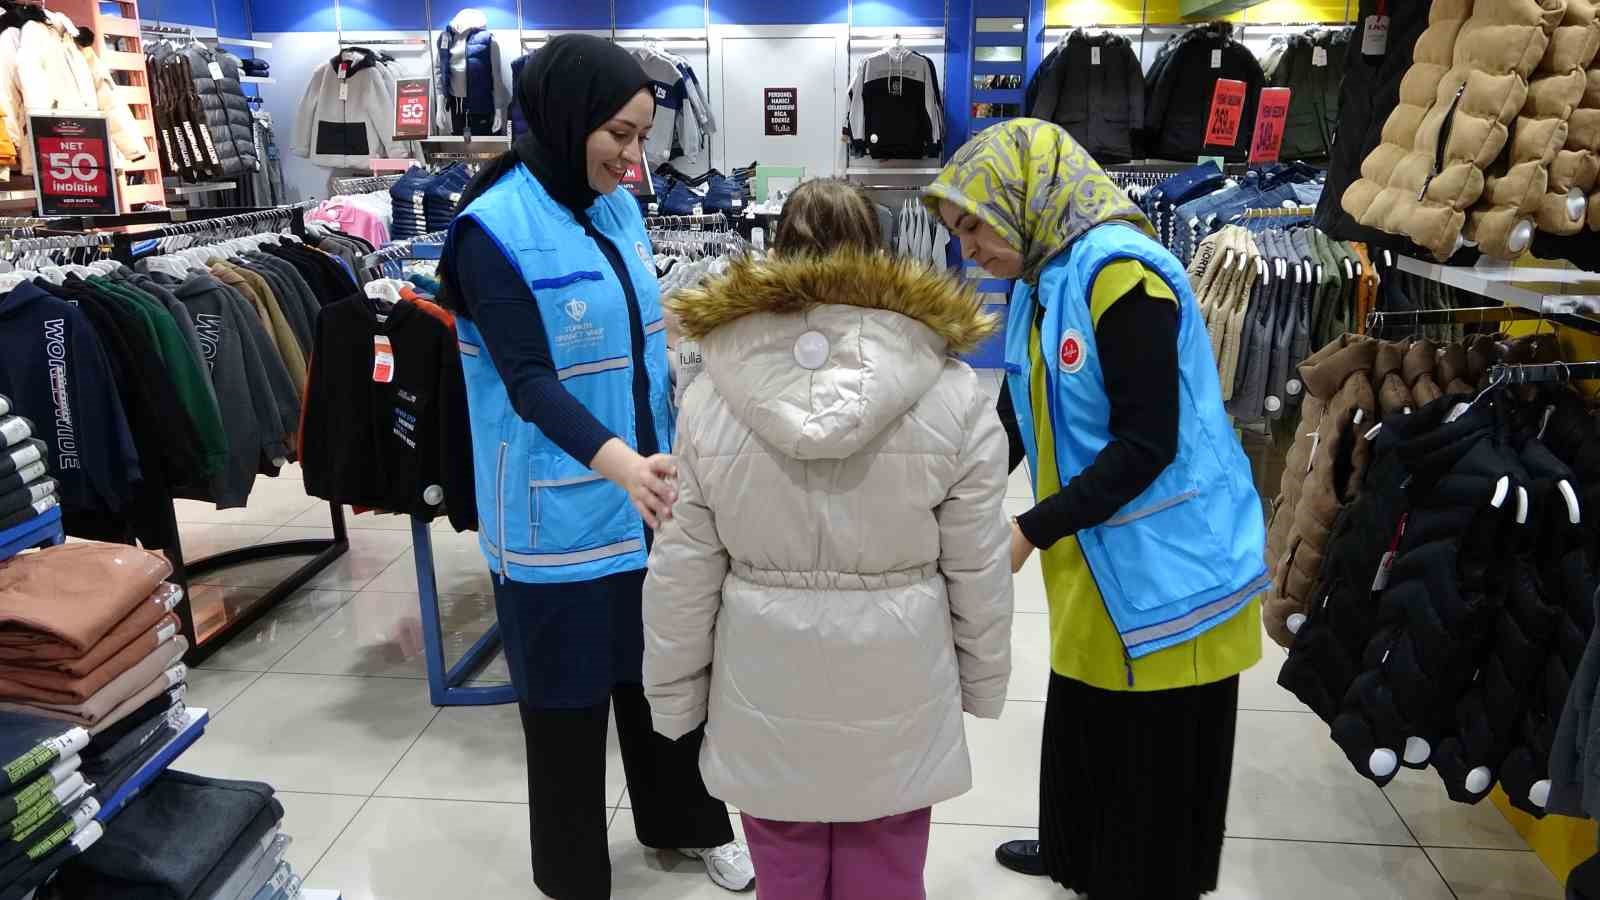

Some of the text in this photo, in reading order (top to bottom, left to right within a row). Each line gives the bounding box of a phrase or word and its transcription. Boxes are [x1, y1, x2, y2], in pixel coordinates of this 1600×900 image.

[401, 103, 424, 118] 50
[60, 141, 84, 151] NET
[49, 152, 98, 181] 50
[52, 180, 98, 193] İNDİRİM
